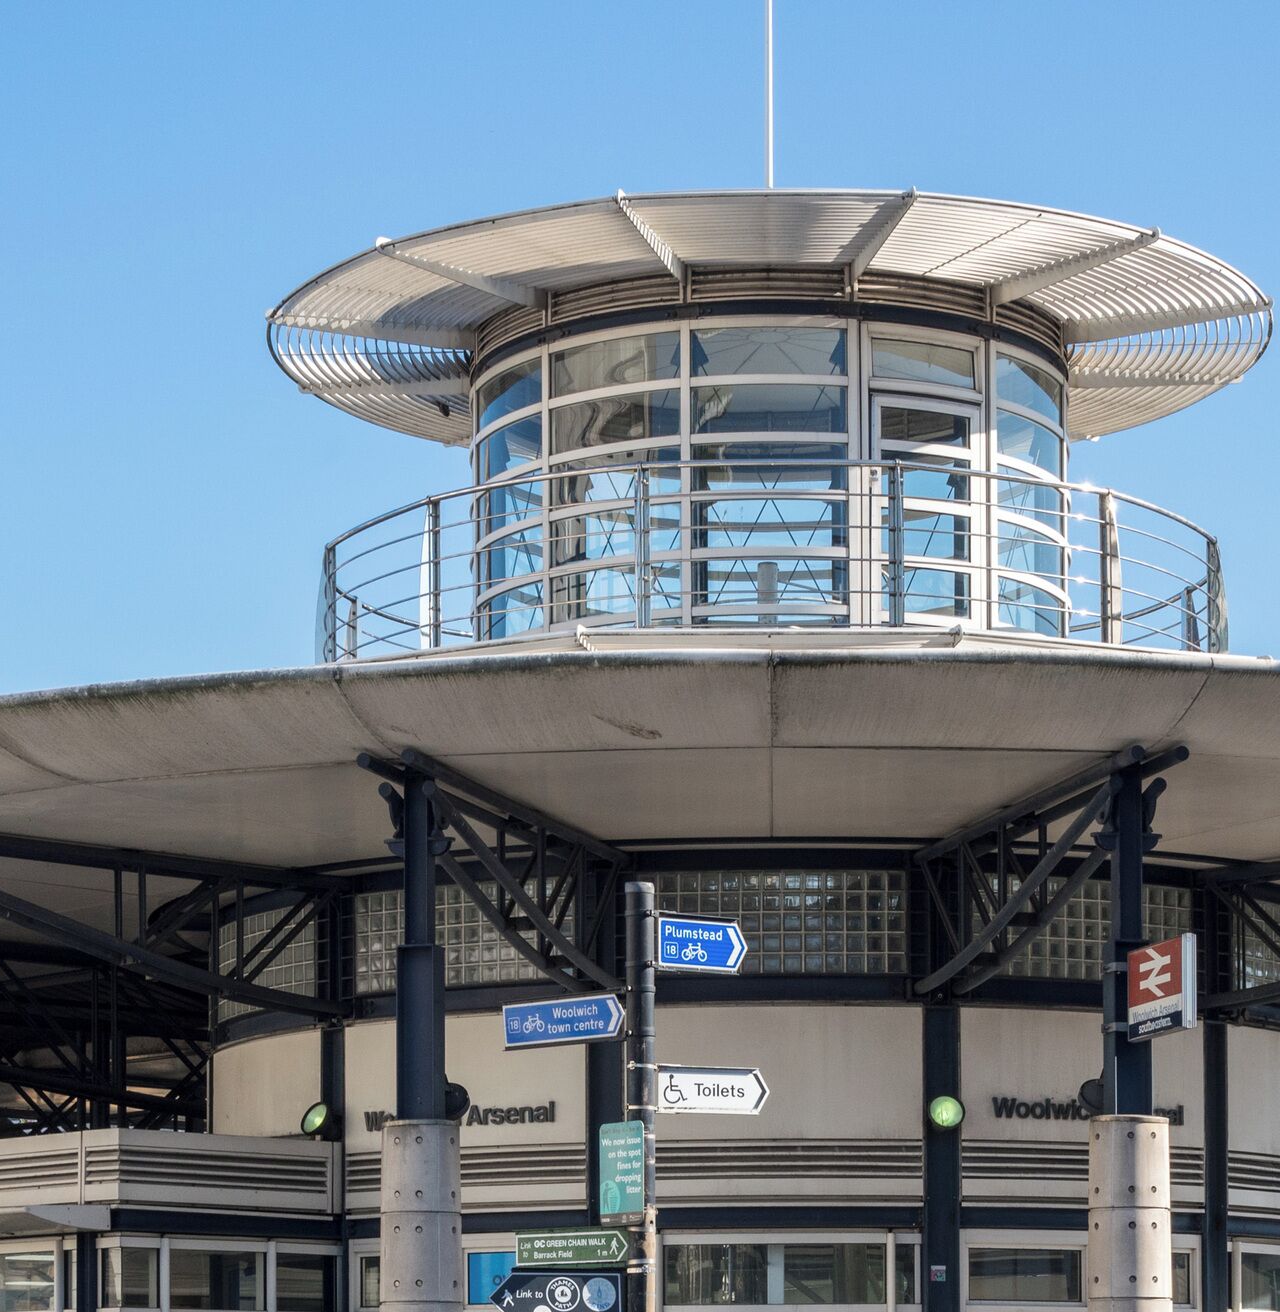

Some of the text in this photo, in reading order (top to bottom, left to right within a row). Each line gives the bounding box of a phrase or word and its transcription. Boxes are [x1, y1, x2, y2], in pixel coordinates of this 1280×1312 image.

[664, 925, 723, 941] Plumstead
[665, 945, 677, 955] 18
[552, 1004, 598, 1019] Woolwich
[509, 1020, 519, 1030] 18
[547, 1019, 604, 1034] town centre
[694, 1083, 745, 1098] Toilets
[466, 1101, 556, 1126] Arsenal
[991, 1097, 1091, 1121] Woolwic
[601, 1138, 612, 1147] We
[626, 1136, 641, 1145] issue
[617, 1149, 628, 1158] the
[628, 1149, 642, 1159] spot
[617, 1160, 641, 1171] fines for
[614, 1174, 642, 1184] dropping
[625, 1185, 641, 1195] litter
[520, 1242, 531, 1250] Link
[546, 1239, 567, 1248] GREEN
[567, 1239, 588, 1247] CHAIN
[588, 1238, 606, 1246] WALK
[523, 1250, 529, 1258] to
[533, 1251, 557, 1259] Barrack
[558, 1250, 573, 1258] Field
[549, 1279, 576, 1291] THAMES
[516, 1289, 544, 1299] Link to
[554, 1300, 573, 1309] PATH
